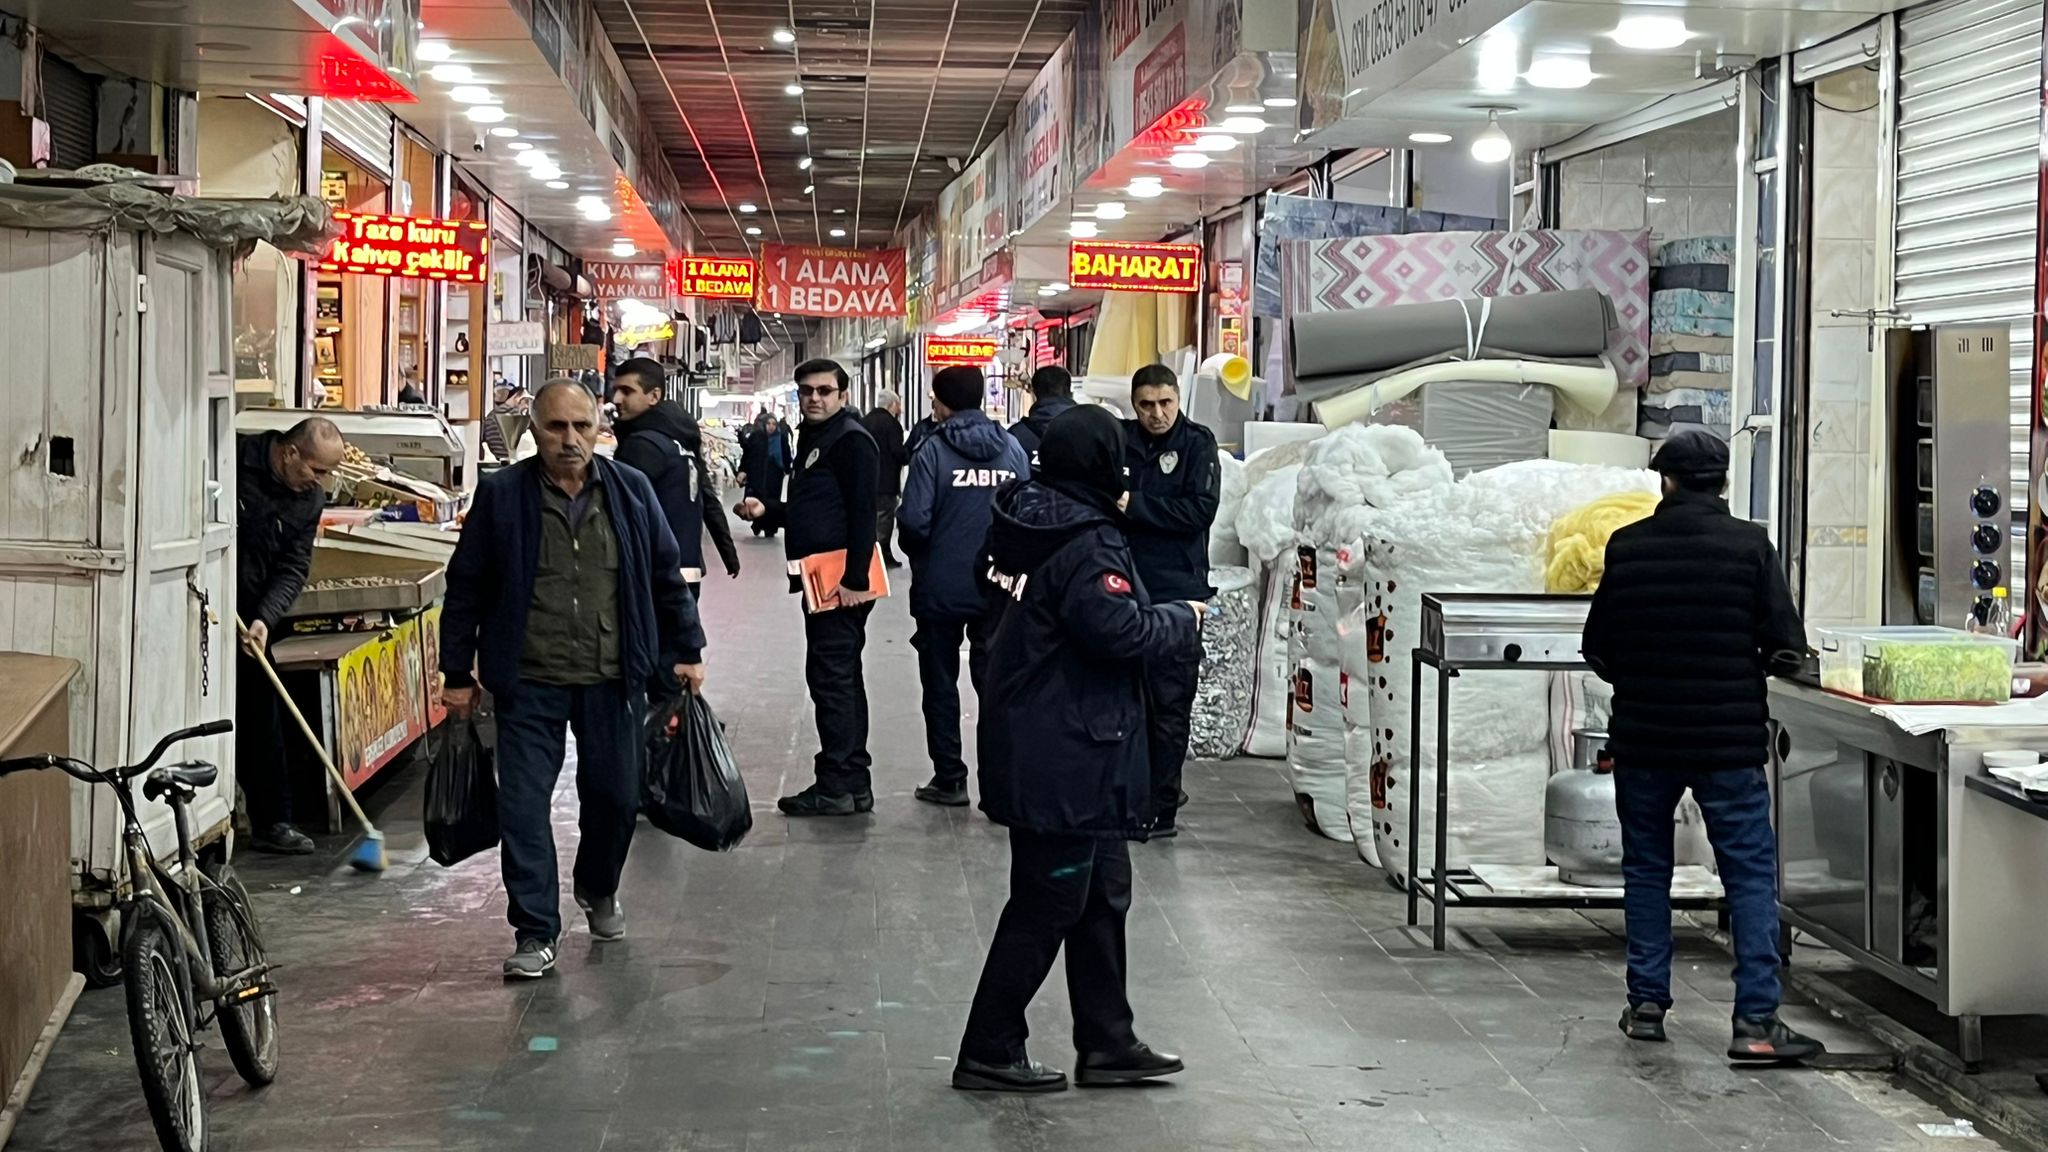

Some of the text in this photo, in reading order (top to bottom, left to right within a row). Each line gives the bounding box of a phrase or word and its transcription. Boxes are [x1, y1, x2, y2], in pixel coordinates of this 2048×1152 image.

[1371, 0, 1393, 65] 0539
[351, 217, 456, 245] Taze kuru
[333, 241, 401, 266] Kahve
[1074, 252, 1195, 280] BAHARAT
[688, 262, 749, 277] 1 ALANA
[776, 256, 890, 286] 1 ALANA
[684, 279, 752, 295] 1 BEDAVA
[767, 284, 897, 313] 1 BEDAVA
